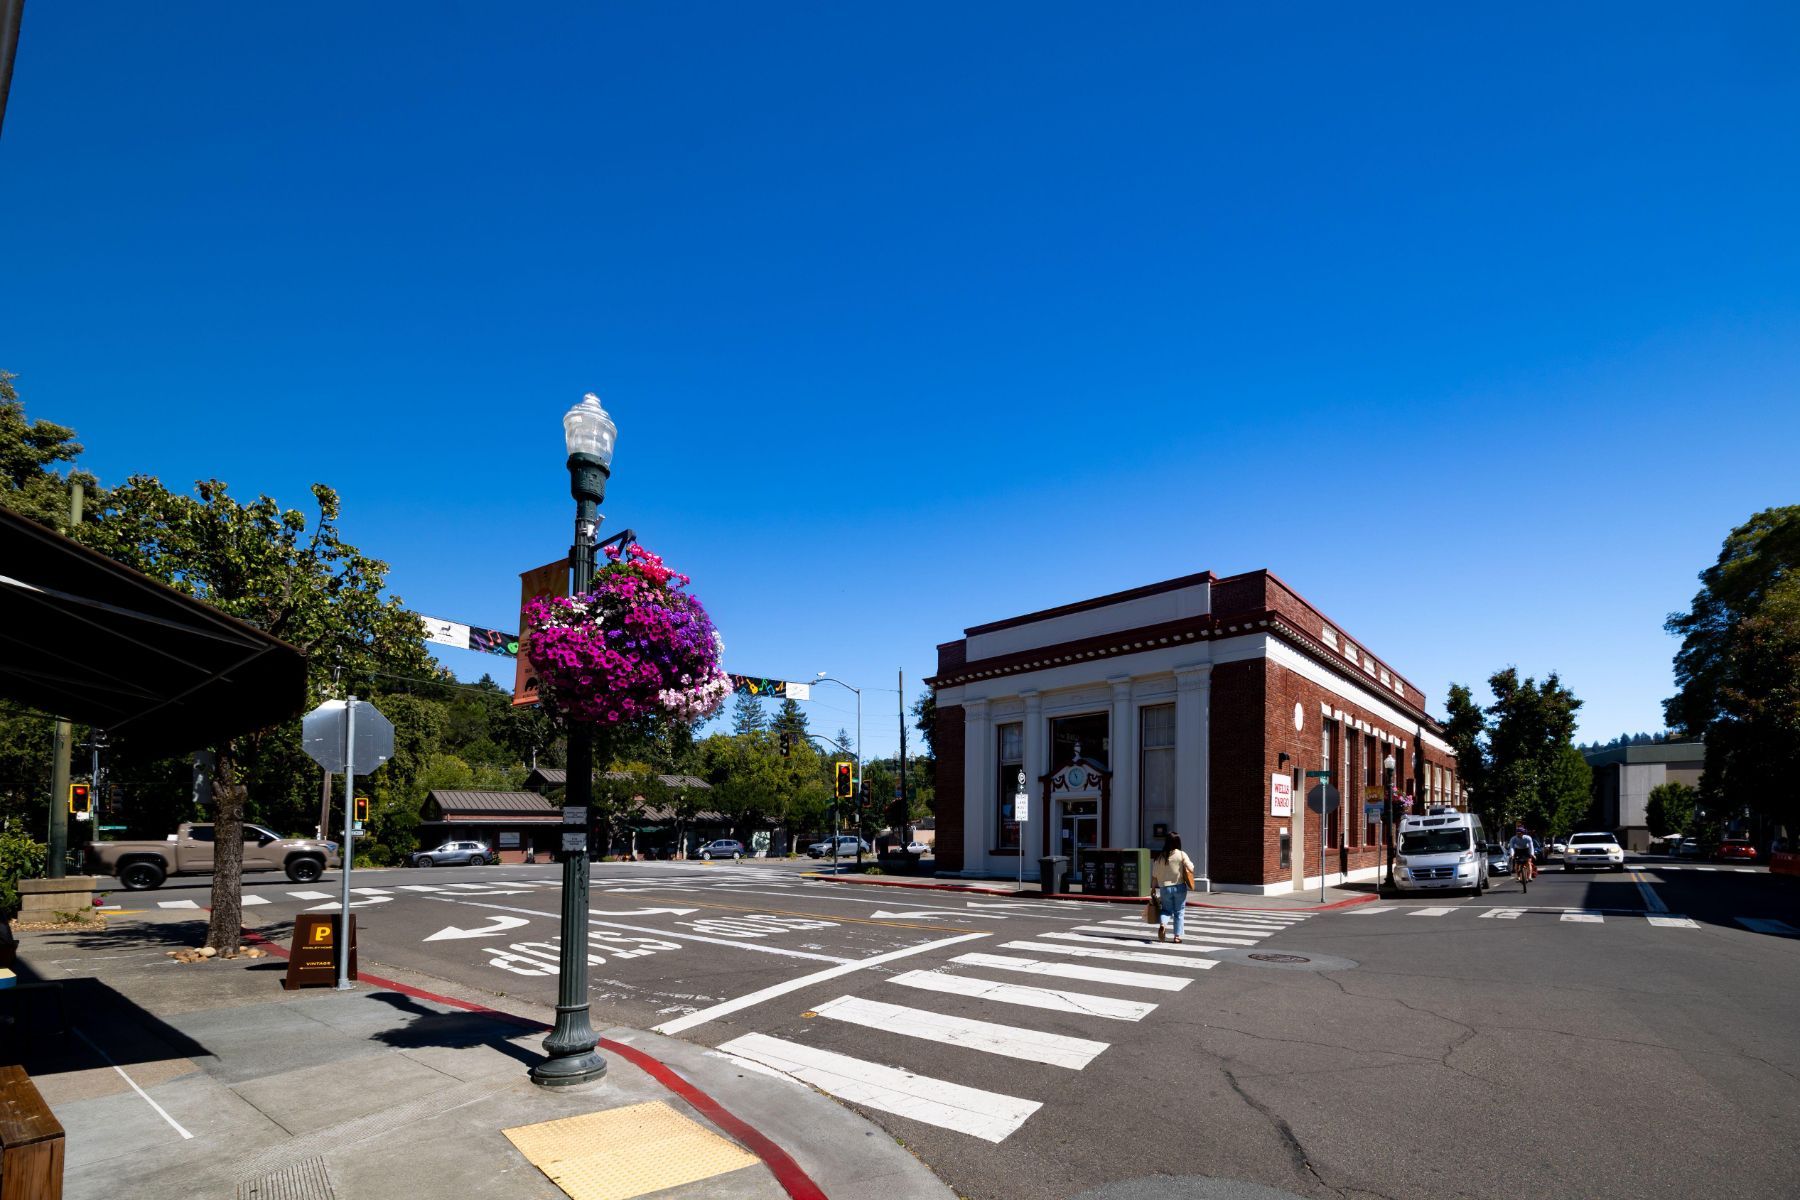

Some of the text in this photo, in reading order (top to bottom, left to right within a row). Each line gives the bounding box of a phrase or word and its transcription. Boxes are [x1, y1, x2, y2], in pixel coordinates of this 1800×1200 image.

[1274, 783, 1290, 795] WELLS
[1274, 797, 1290, 807] FARGO
[674, 914, 841, 938] STOP
